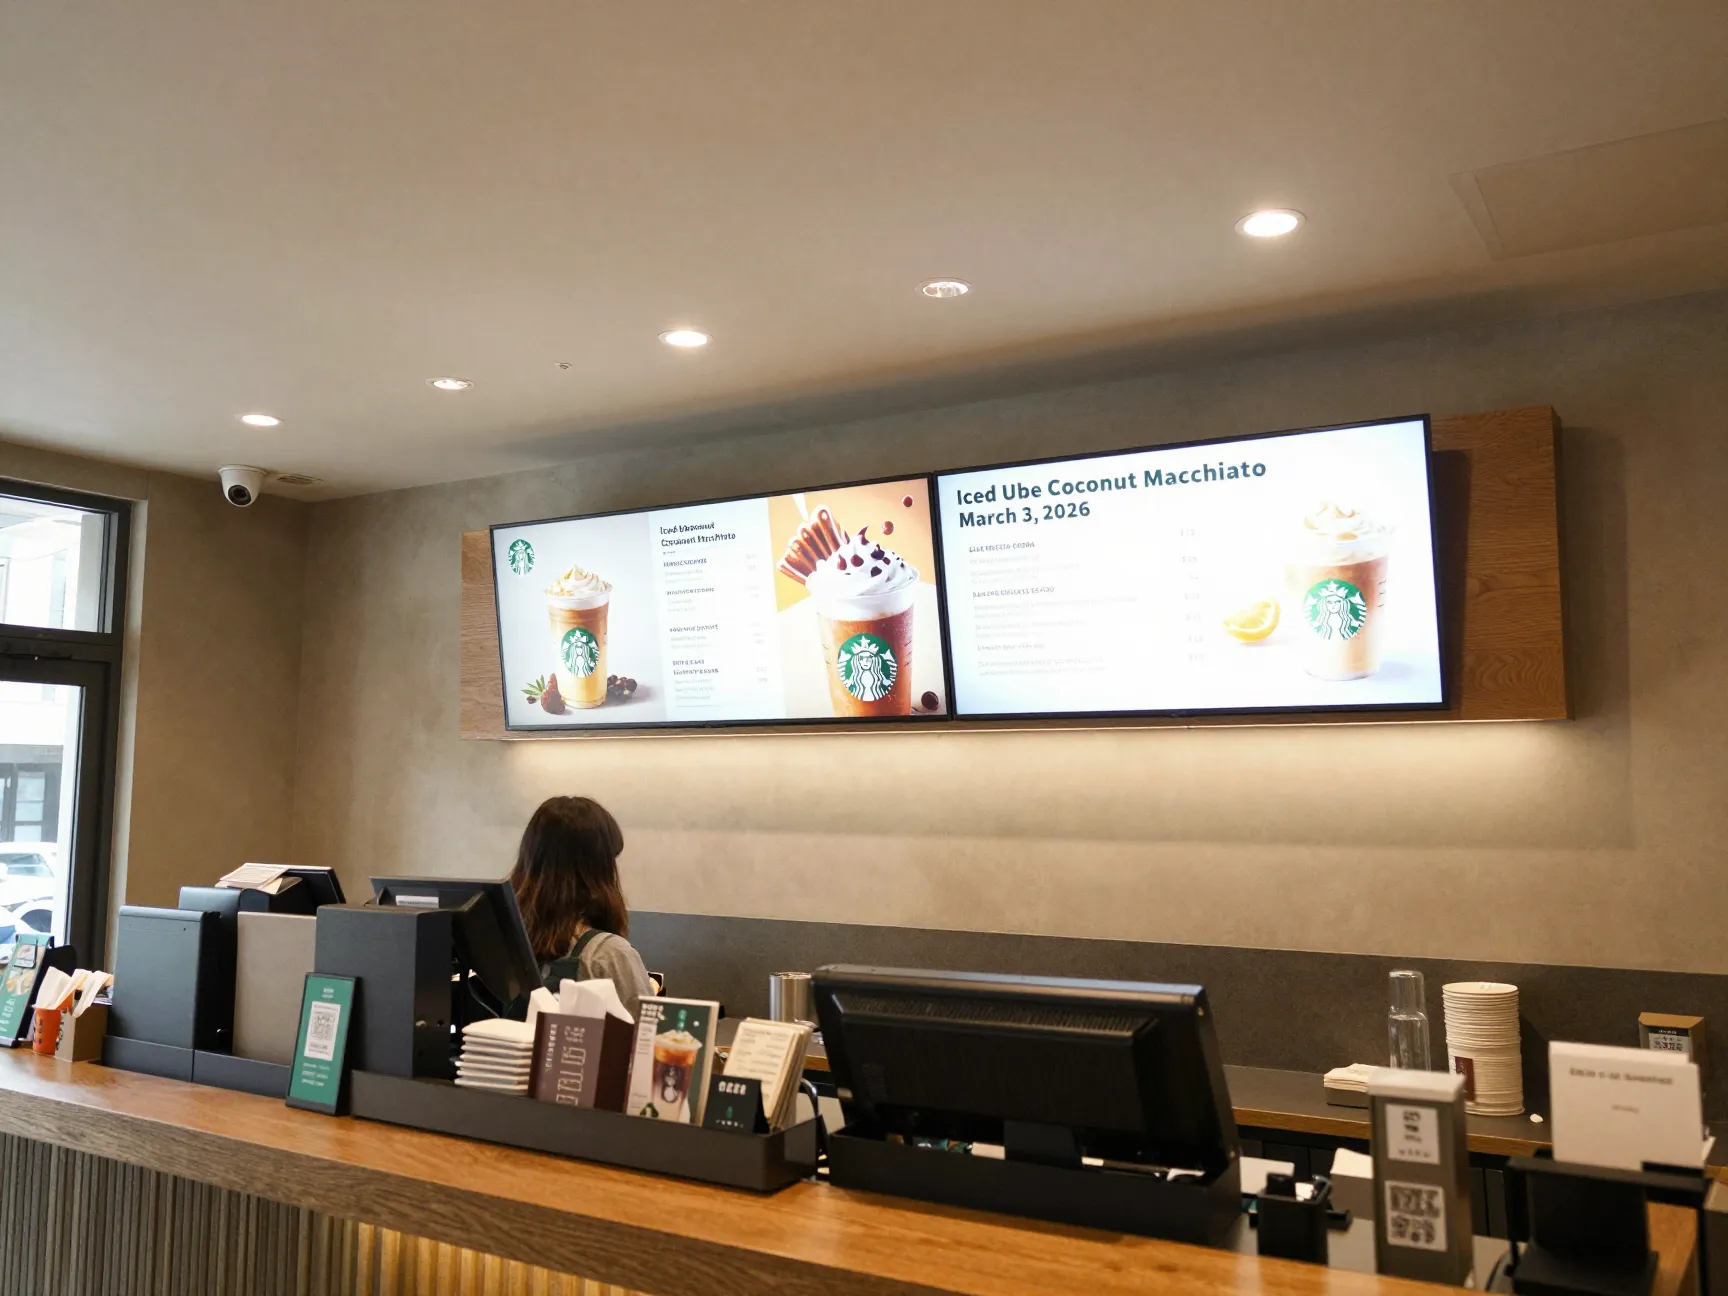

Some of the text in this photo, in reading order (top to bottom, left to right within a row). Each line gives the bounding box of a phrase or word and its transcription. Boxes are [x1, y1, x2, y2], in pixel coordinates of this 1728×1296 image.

[956, 461, 1267, 506] Iced Ube Coconut Macchiato
[959, 501, 1091, 528] March 3, 2026
